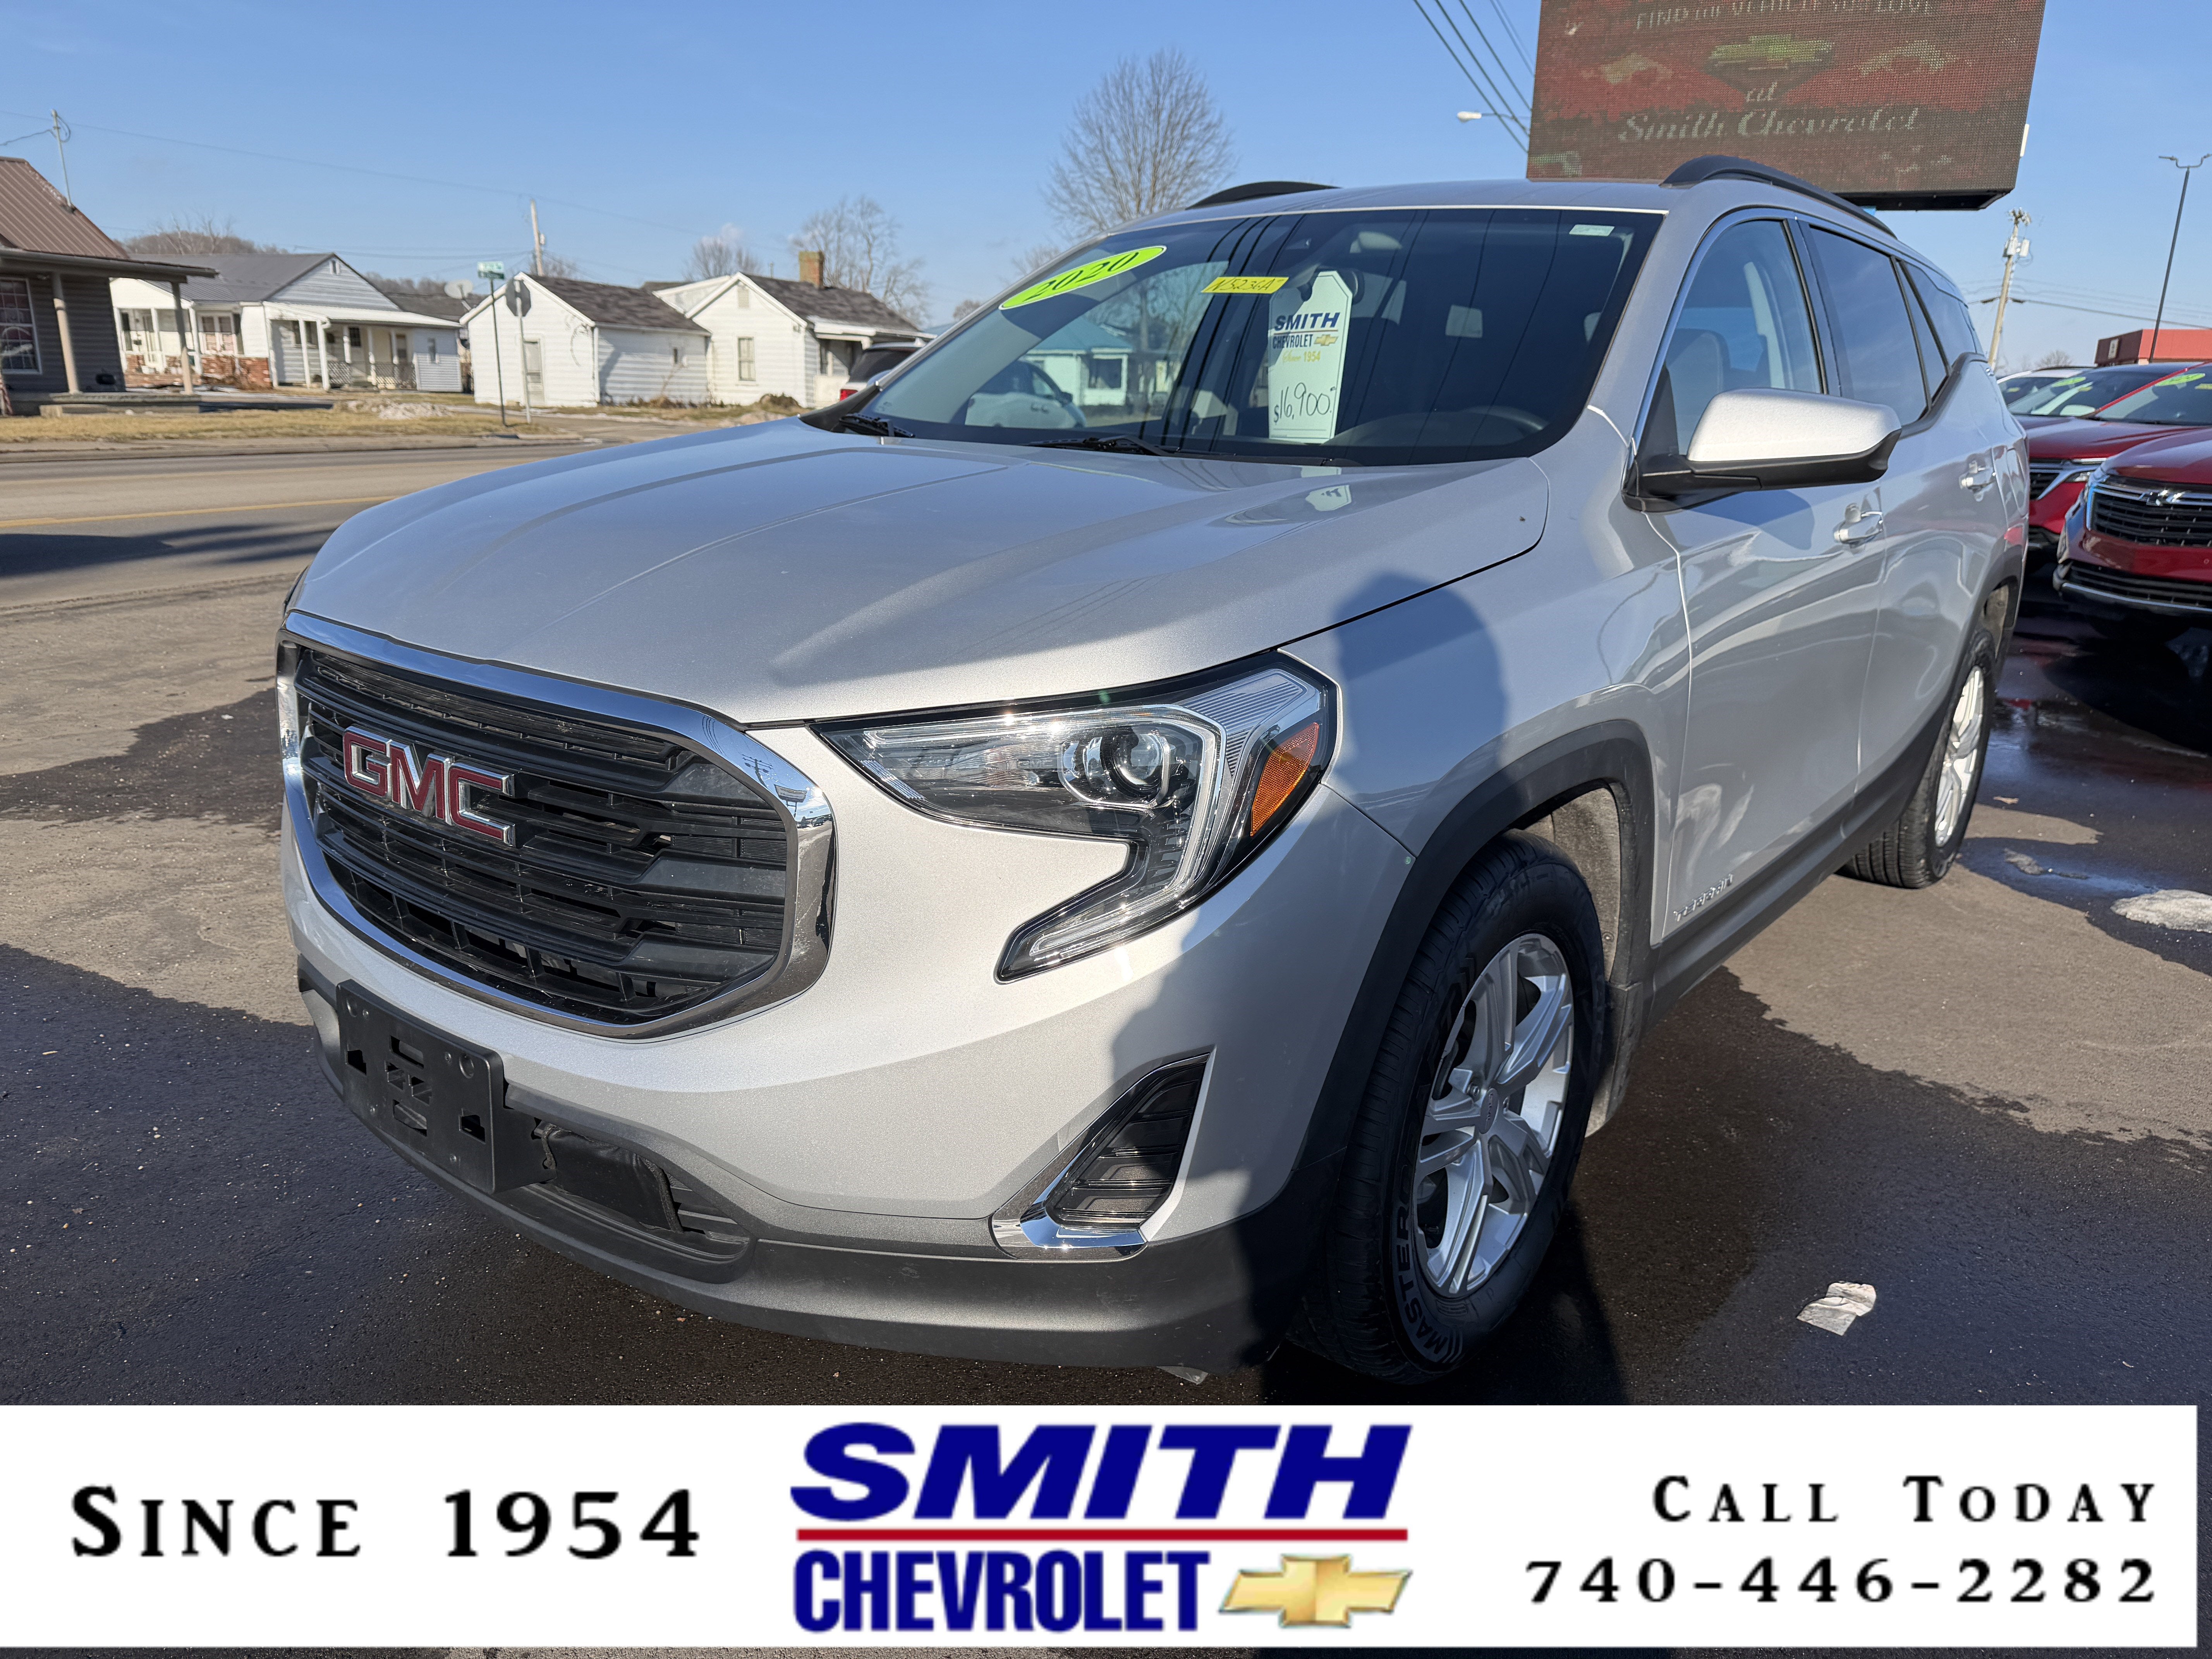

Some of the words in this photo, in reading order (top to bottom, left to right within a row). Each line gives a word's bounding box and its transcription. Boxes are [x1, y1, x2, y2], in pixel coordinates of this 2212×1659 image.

[1618, 110, 1726, 142] Smith
[1022, 252, 1139, 302] 2020
[1274, 312, 1340, 331] SMITH
[1273, 334, 1313, 349] CHEVROLET
[1304, 350, 1321, 362] 1954
[343, 724, 516, 848] GMC
